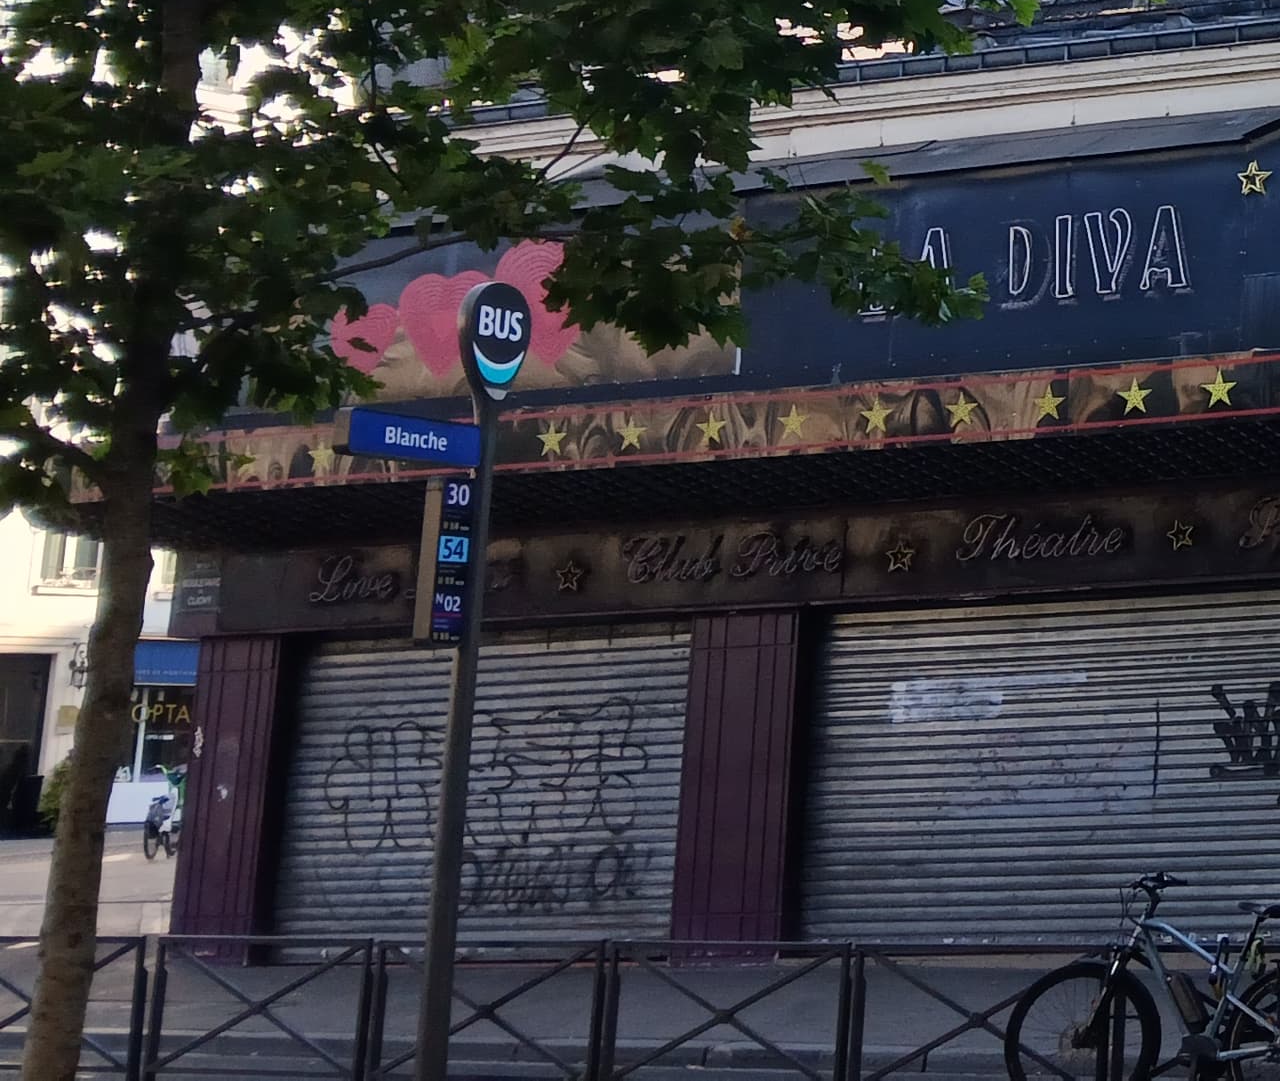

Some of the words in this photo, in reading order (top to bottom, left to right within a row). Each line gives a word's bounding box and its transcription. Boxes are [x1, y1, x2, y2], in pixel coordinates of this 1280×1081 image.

[1004, 205, 1190, 304] DIVA
[478, 305, 524, 342] BUS
[384, 426, 448, 452] Blanche
[447, 483, 470, 506] 30
[442, 538, 464, 560] 54
